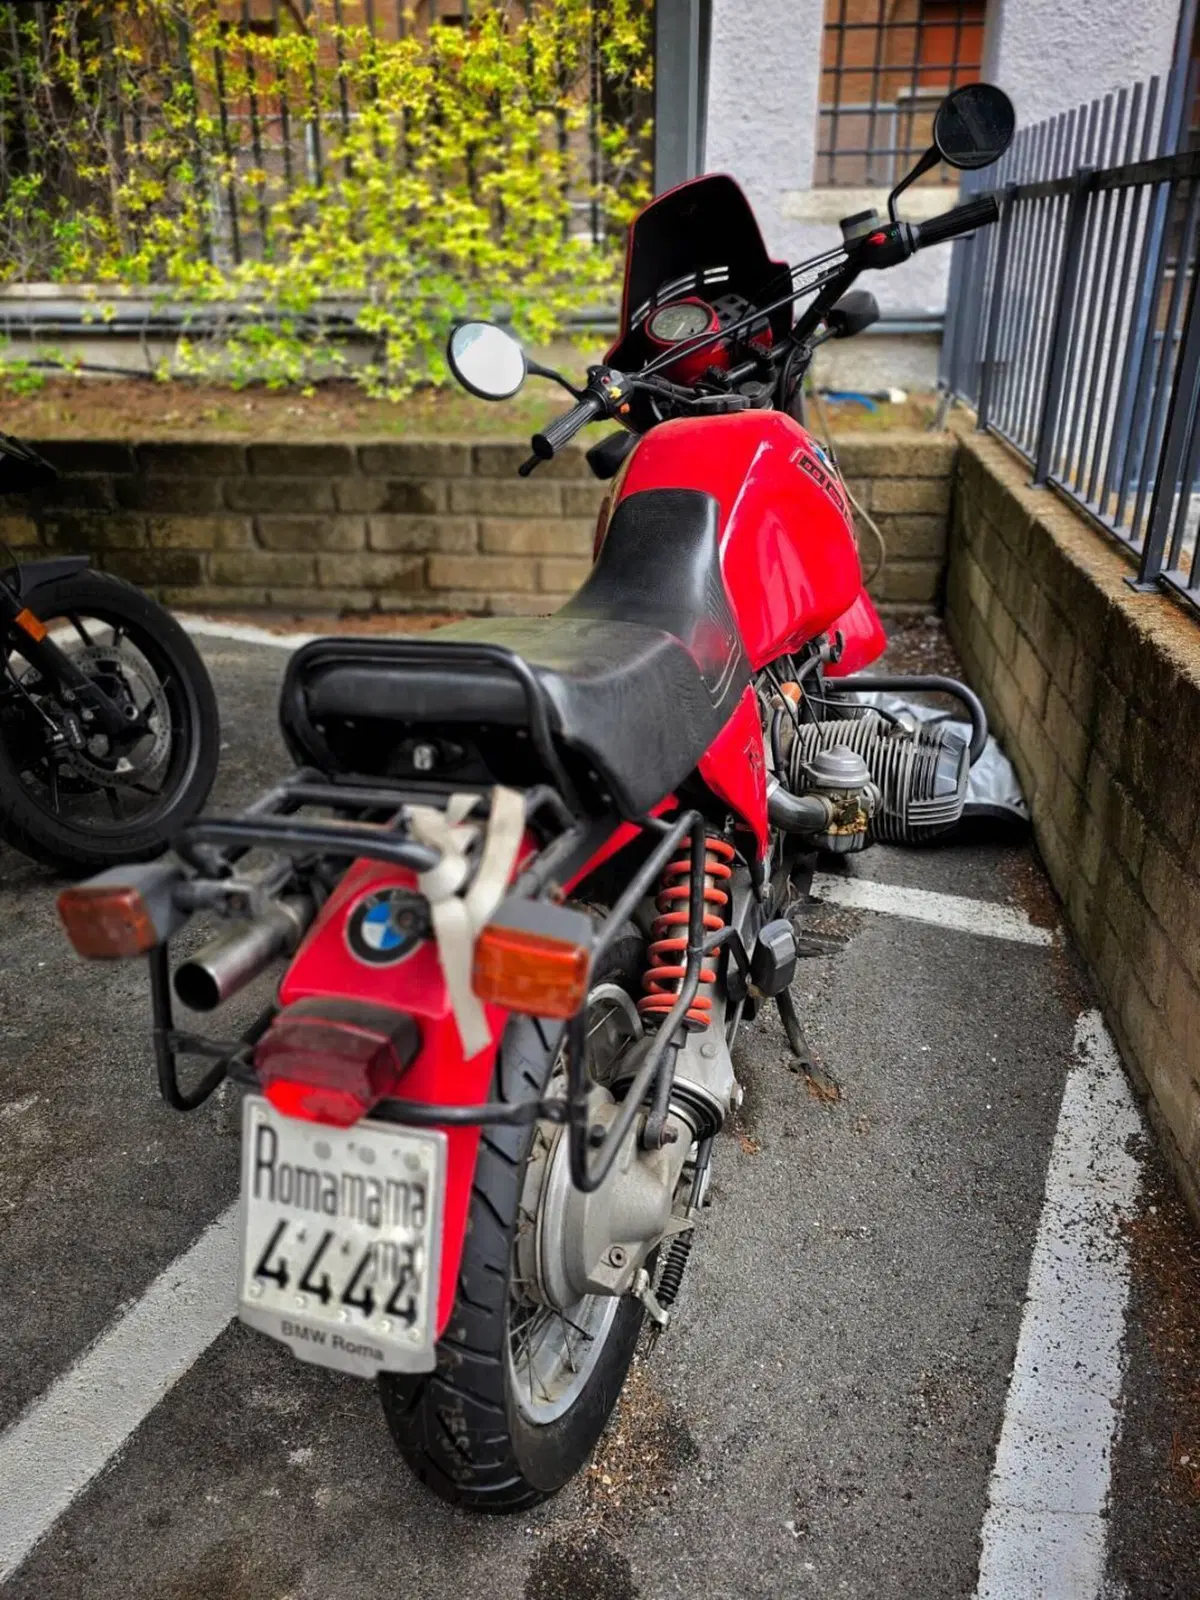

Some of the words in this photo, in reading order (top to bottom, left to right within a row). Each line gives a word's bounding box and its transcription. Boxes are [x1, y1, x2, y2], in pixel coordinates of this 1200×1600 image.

[253, 1123, 427, 1230] Romamama
[281, 1319, 327, 1346] BMW
[331, 1333, 385, 1362] Roma
